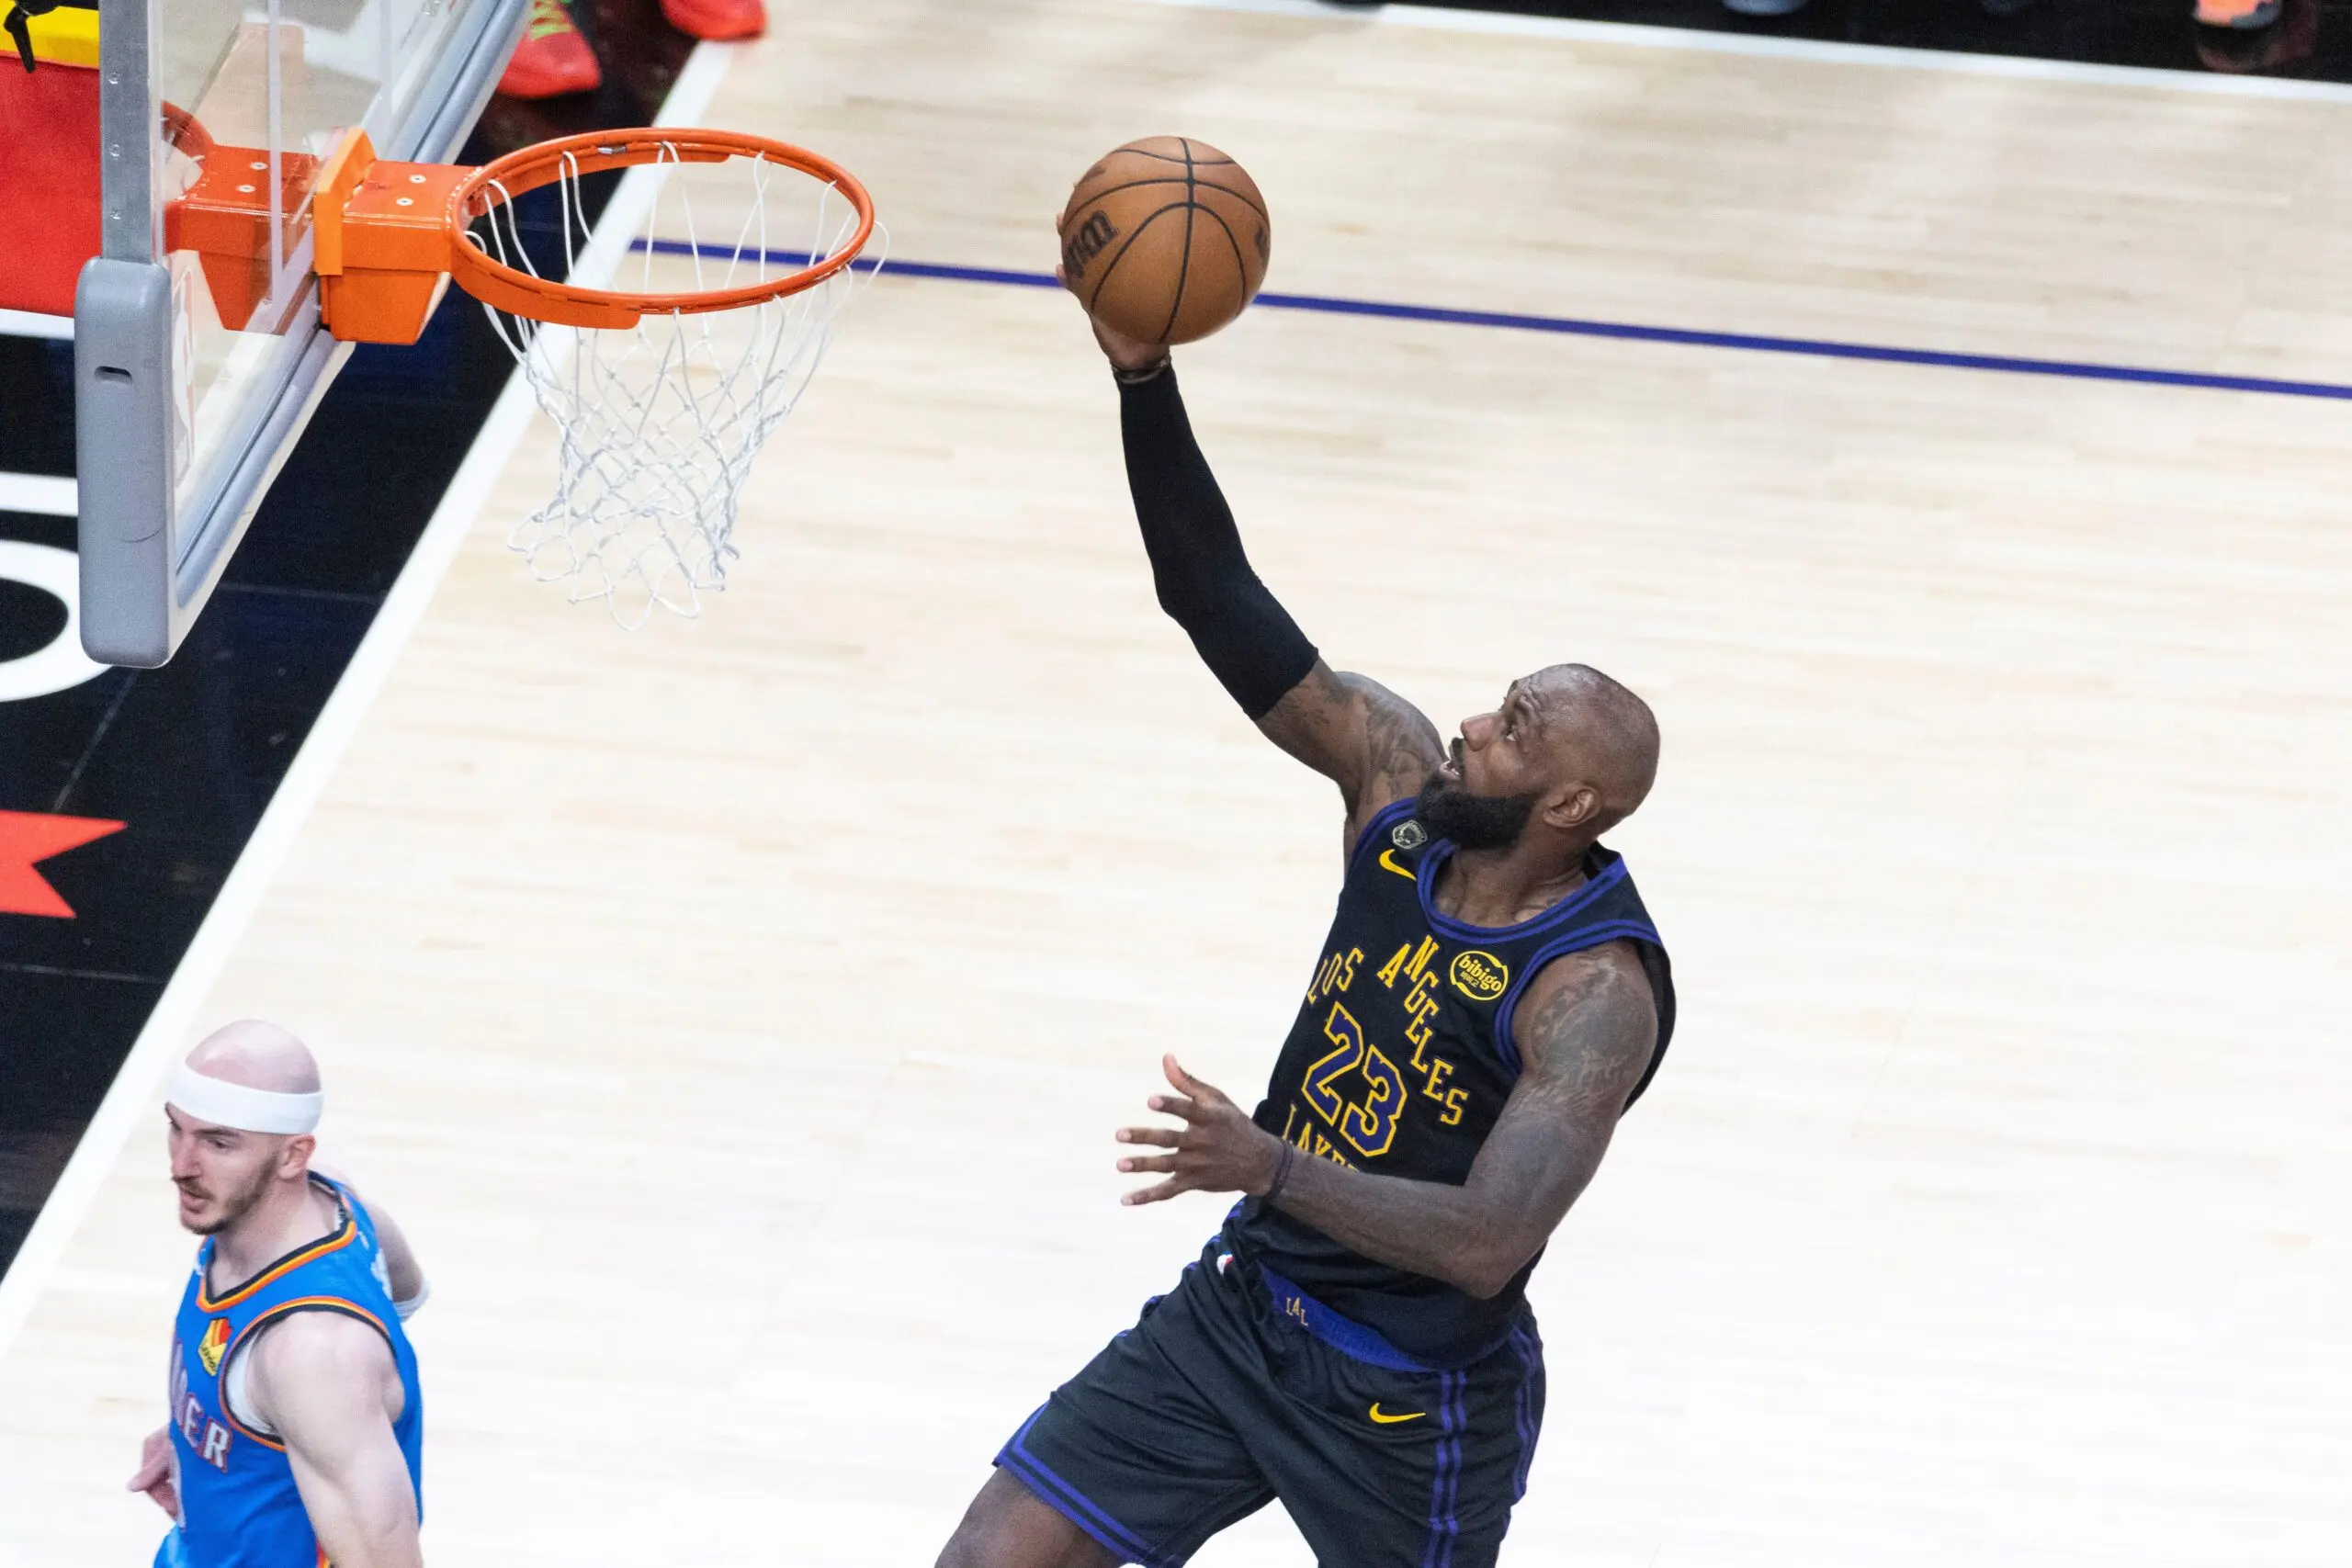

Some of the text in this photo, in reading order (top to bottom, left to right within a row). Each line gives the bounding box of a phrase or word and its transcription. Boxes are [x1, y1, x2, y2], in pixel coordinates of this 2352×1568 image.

[1458, 954, 1502, 992] bibigo
[1301, 999, 1408, 1157] 23
[1306, 934, 1469, 1126] LOS ANGELES
[1286, 1296, 1308, 1327] LAL
